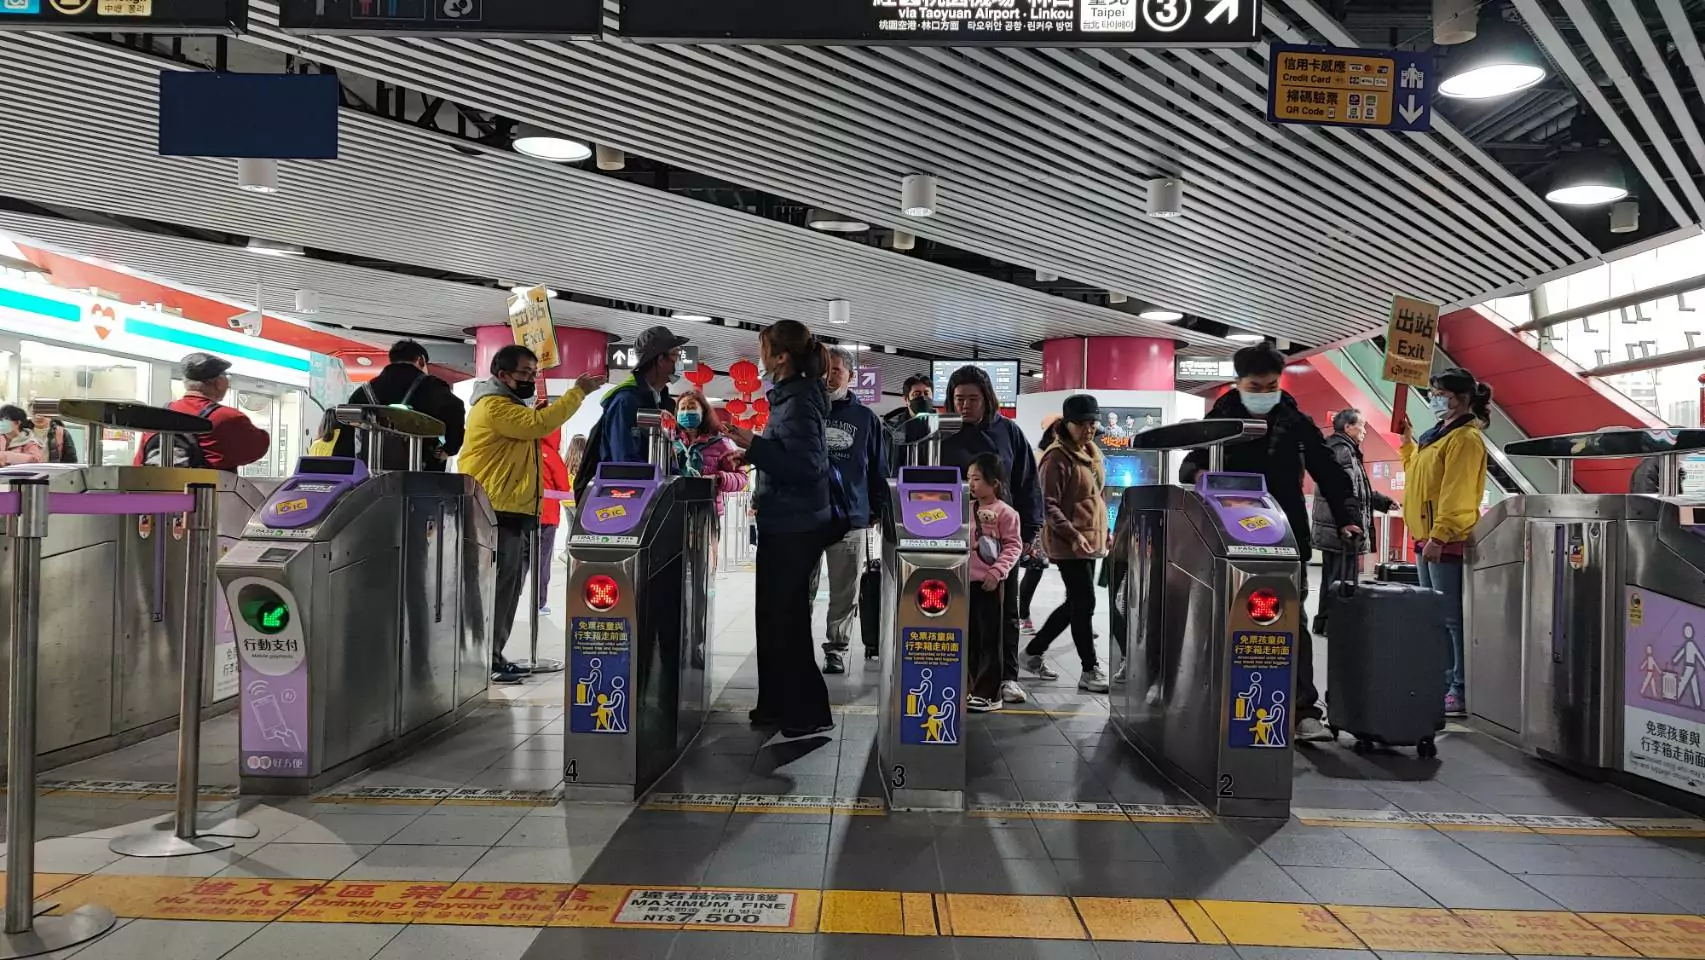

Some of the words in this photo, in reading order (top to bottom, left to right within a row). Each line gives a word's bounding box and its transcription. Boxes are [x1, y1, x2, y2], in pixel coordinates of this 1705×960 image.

[898, 7, 917, 19] via
[919, 7, 972, 21] Taoyuan
[975, 8, 1020, 21] Airport
[1031, 8, 1073, 19] Linkou
[1091, 8, 1125, 19] Taipei
[1156, 0, 1177, 23] 3
[967, 21, 1002, 31] 타오위안
[1056, 21, 1073, 31] 방면
[1083, 20, 1100, 30] 台北
[1101, 20, 1133, 30] 타이베이
[1284, 57, 1346, 74] 信用卡感應
[1283, 73, 1308, 83] Credit
[1310, 74, 1331, 84] Card
[1286, 89, 1338, 105] 掃碼驗票
[1302, 107, 1324, 116] Code
[514, 304, 547, 329] 出站
[1396, 308, 1434, 339] 出站
[523, 328, 546, 347] Exit
[1397, 340, 1425, 360] Exit
[574, 631, 628, 641] 行李箱走前面
[243, 638, 298, 651] 行動支付
[905, 641, 959, 652] 行李箱走前面
[1235, 645, 1290, 655] 行李箱走前面
[1646, 720, 1700, 748] 免票孩童與
[1640, 736, 1705, 768] 行李箱走前面
[273, 758, 303, 769] 好方便
[565, 759, 579, 782] 4
[892, 765, 906, 788] 3
[1219, 774, 1234, 796] 2
[181, 881, 386, 899] 進入本區
[400, 884, 596, 903] 禁止飲食
[640, 891, 779, 902] 違者最高罰鍰
[155, 896, 190, 904] No
[196, 897, 268, 907] Eating
[309, 899, 406, 910] Drinking
[413, 901, 504, 911] Beyond
[509, 903, 552, 911] this
[631, 900, 729, 908] MAXIMUM
[741, 902, 787, 910] FINE
[1302, 923, 1339, 934] No
